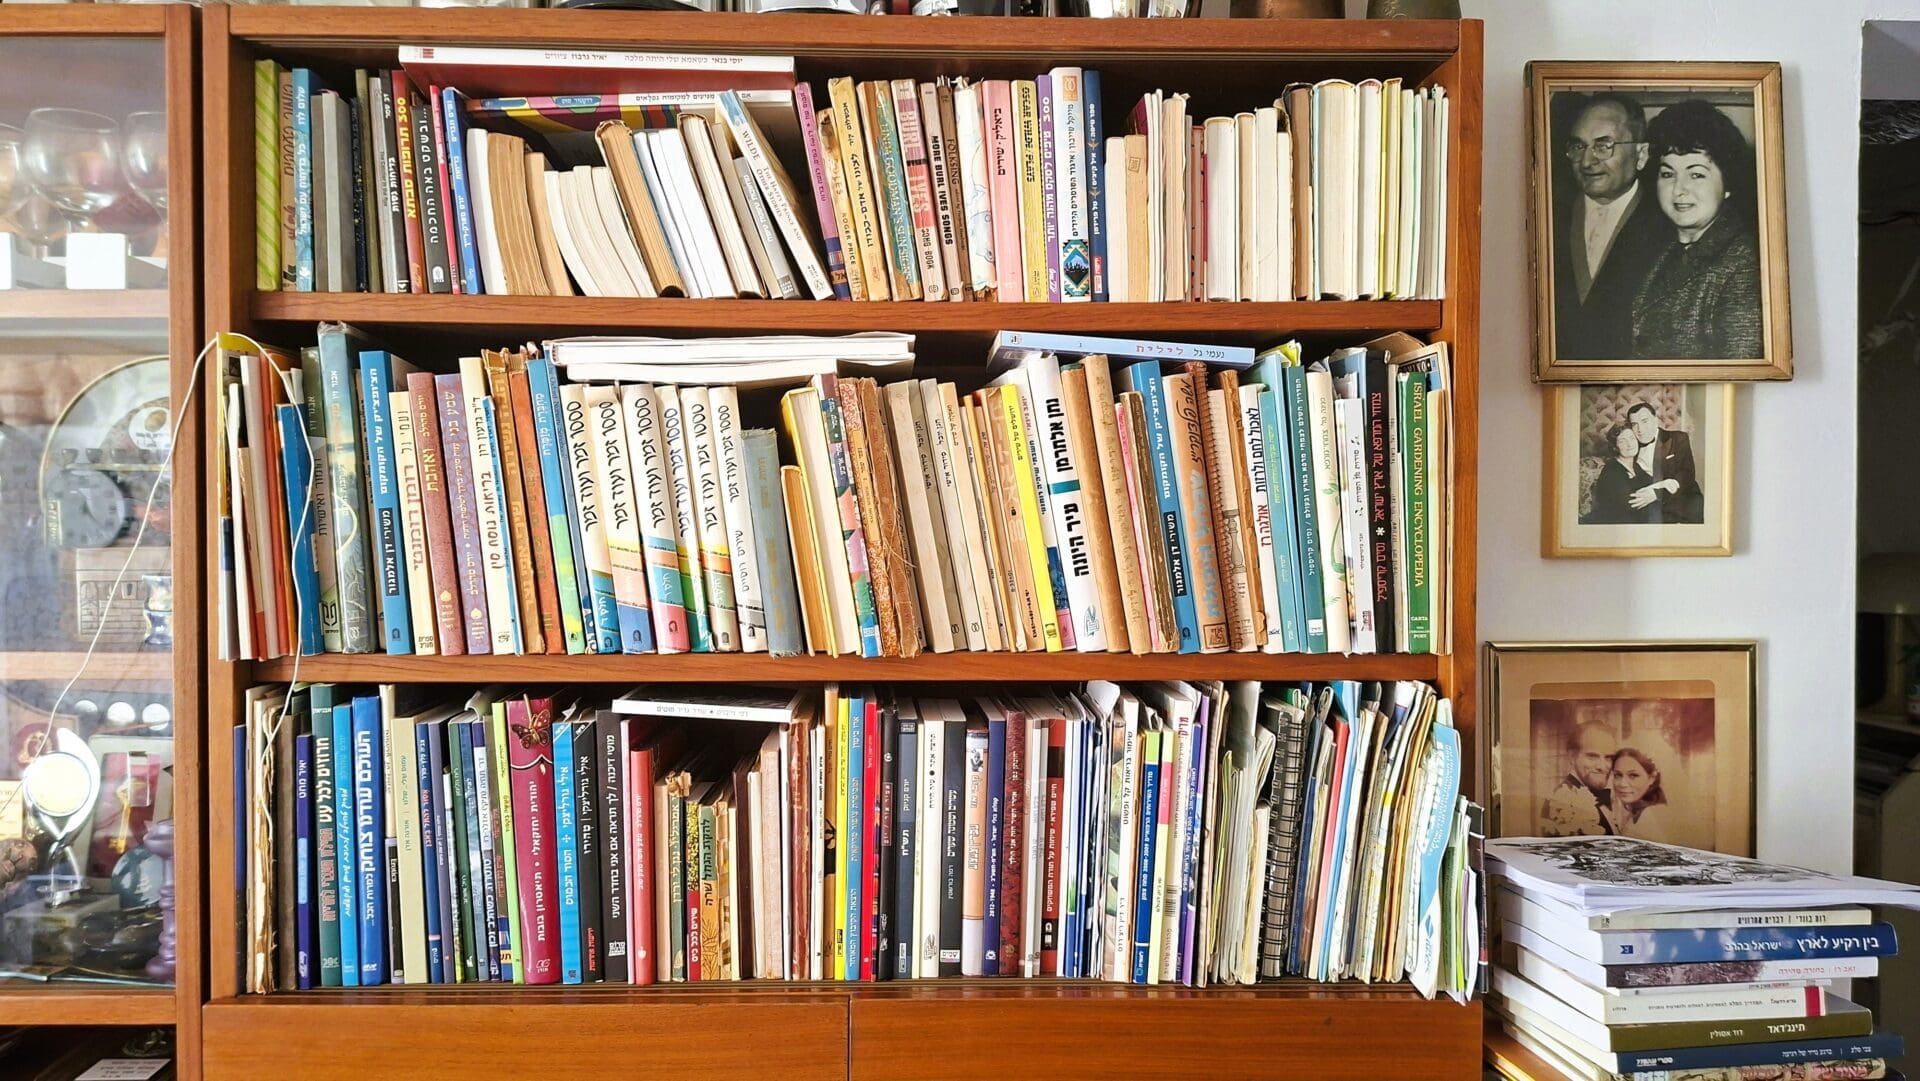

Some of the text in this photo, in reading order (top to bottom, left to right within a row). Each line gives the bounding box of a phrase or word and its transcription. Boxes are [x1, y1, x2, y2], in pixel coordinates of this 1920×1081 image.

[1022, 87, 1031, 117] OSCAR
[742, 131, 760, 160] WILDE
[992, 108, 1006, 176] ביאליק שירים
[1024, 120, 1033, 149] WILDE
[1043, 131, 1052, 158] טיפים
[389, 157, 399, 212] בדיחות גסות
[900, 110, 935, 269] BURL IVES SONG BOOK
[931, 135, 953, 245] MORE BURL IVES SONGS
[1044, 162, 1054, 190] לסקס
[1046, 193, 1055, 219] מהנה
[1047, 221, 1056, 242] יותר
[847, 242, 856, 264] PRICE
[1295, 378, 1303, 402] המדריך
[374, 426, 383, 443] של
[1155, 433, 1164, 449] של
[1298, 427, 1307, 451] לצמחי
[573, 442, 592, 468] זמר
[915, 421, 933, 489] חנן יובל סידור אישי
[934, 419, 953, 487] חנן יובל סידור אישי
[1029, 440, 1038, 465] חשבתי
[1300, 453, 1308, 471] מרפא
[376, 447, 388, 494] הקומקום
[1033, 467, 1041, 489] שיהיה
[1159, 453, 1171, 499] הקומקום
[1246, 407, 1272, 546] לאכול לחם ולרזות אולגה רז
[1301, 473, 1309, 492] בארץ
[1412, 381, 1425, 588] ISRAEL GARDENING ENCYCLOPEDIA
[579, 471, 592, 502] ועוד
[1046, 398, 1089, 576] נתן אלתרמן עיר היונה
[1371, 392, 1389, 602] צמחי המרפא של ארץ ישראל נסים קריספיל
[582, 504, 599, 532] זמר
[1303, 494, 1311, 518] ובעולם
[1166, 514, 1177, 542] משירי
[1305, 528, 1314, 546] נסים
[380, 510, 397, 594] משירי דן אלמגור
[1170, 546, 1180, 554] דן
[1306, 547, 1315, 576] קריספיל
[1173, 558, 1185, 594] אלמגור
[357, 731, 372, 782] העולם
[1124, 757, 1132, 783] בריאות
[298, 760, 307, 799] יאיר מחט
[1123, 787, 1131, 798] קל
[358, 787, 372, 827] עודנו
[901, 779, 911, 856] יורם קניוק תש"ח
[560, 766, 574, 905] אילי גורליצקי הסוד הכמוס
[607, 735, 620, 919] מוטי דיכנה לך תראה אם אני בחדר השני
[358, 833, 376, 873] צוחק
[529, 781, 546, 942] יהודית יחזקאלי תיאטרון בובות
[701, 819, 714, 906] להקת הנחל שרה
[1048, 851, 1055, 860] על
[390, 858, 398, 883] Erotica
[363, 873, 374, 901] למרות
[1046, 880, 1054, 912] המשחקים
[1765, 916, 1784, 924] דברים
[1817, 915, 1826, 923] רות
[690, 908, 699, 962] שירים לכל כיס
[1752, 942, 1782, 951] ישראל
[1797, 936, 1828, 952] לארץ
[1831, 937, 1859, 951] רקיע
[1863, 936, 1879, 950] בין
